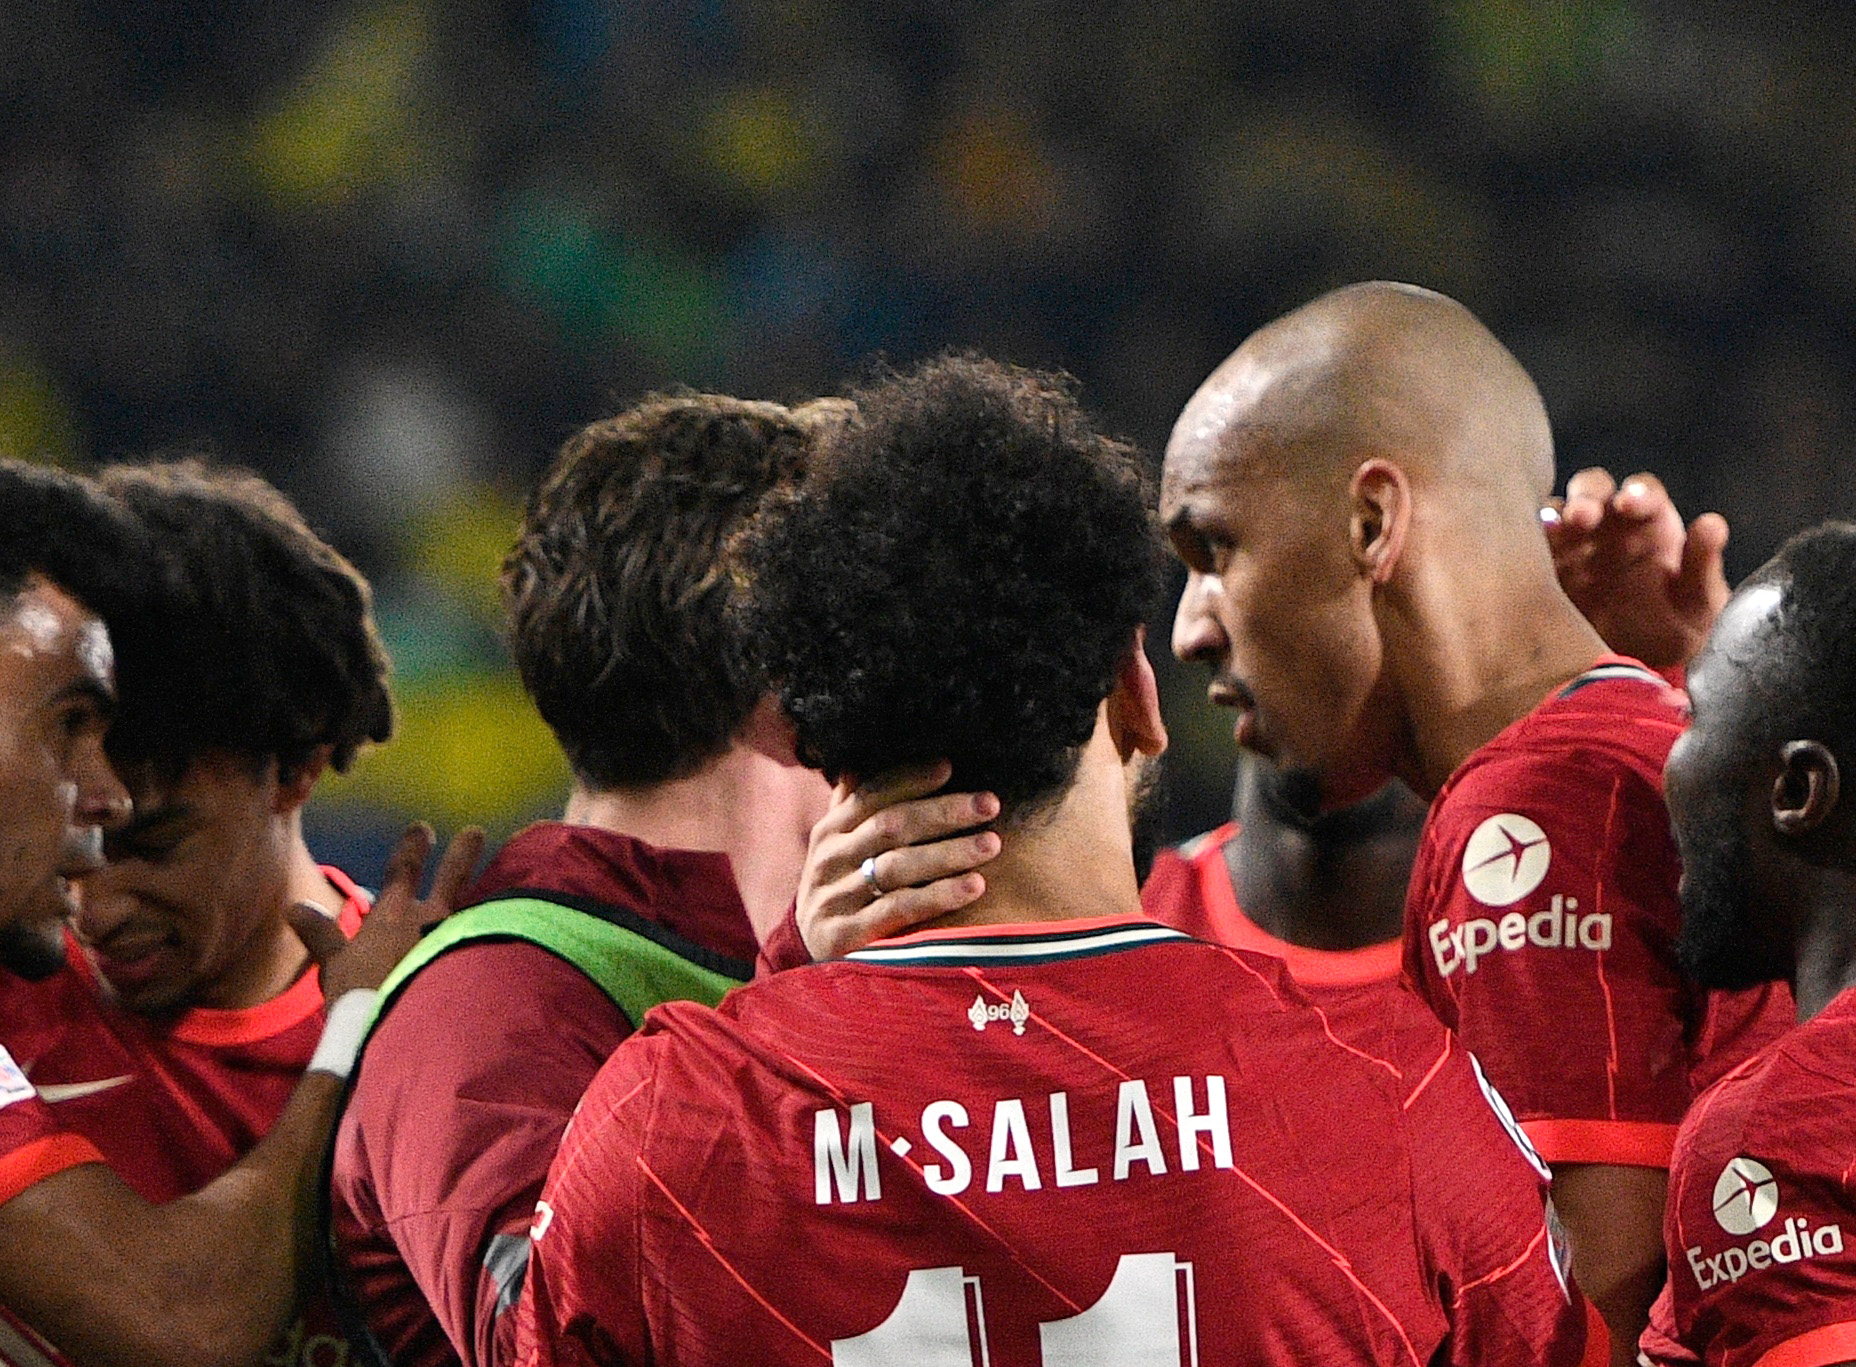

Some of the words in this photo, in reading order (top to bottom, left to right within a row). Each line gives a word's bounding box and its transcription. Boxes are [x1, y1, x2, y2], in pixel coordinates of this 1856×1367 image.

[1429, 894, 1613, 978] Expedia
[987, 1003, 1010, 1022] 96
[1687, 1216, 1844, 1292] Expedia
